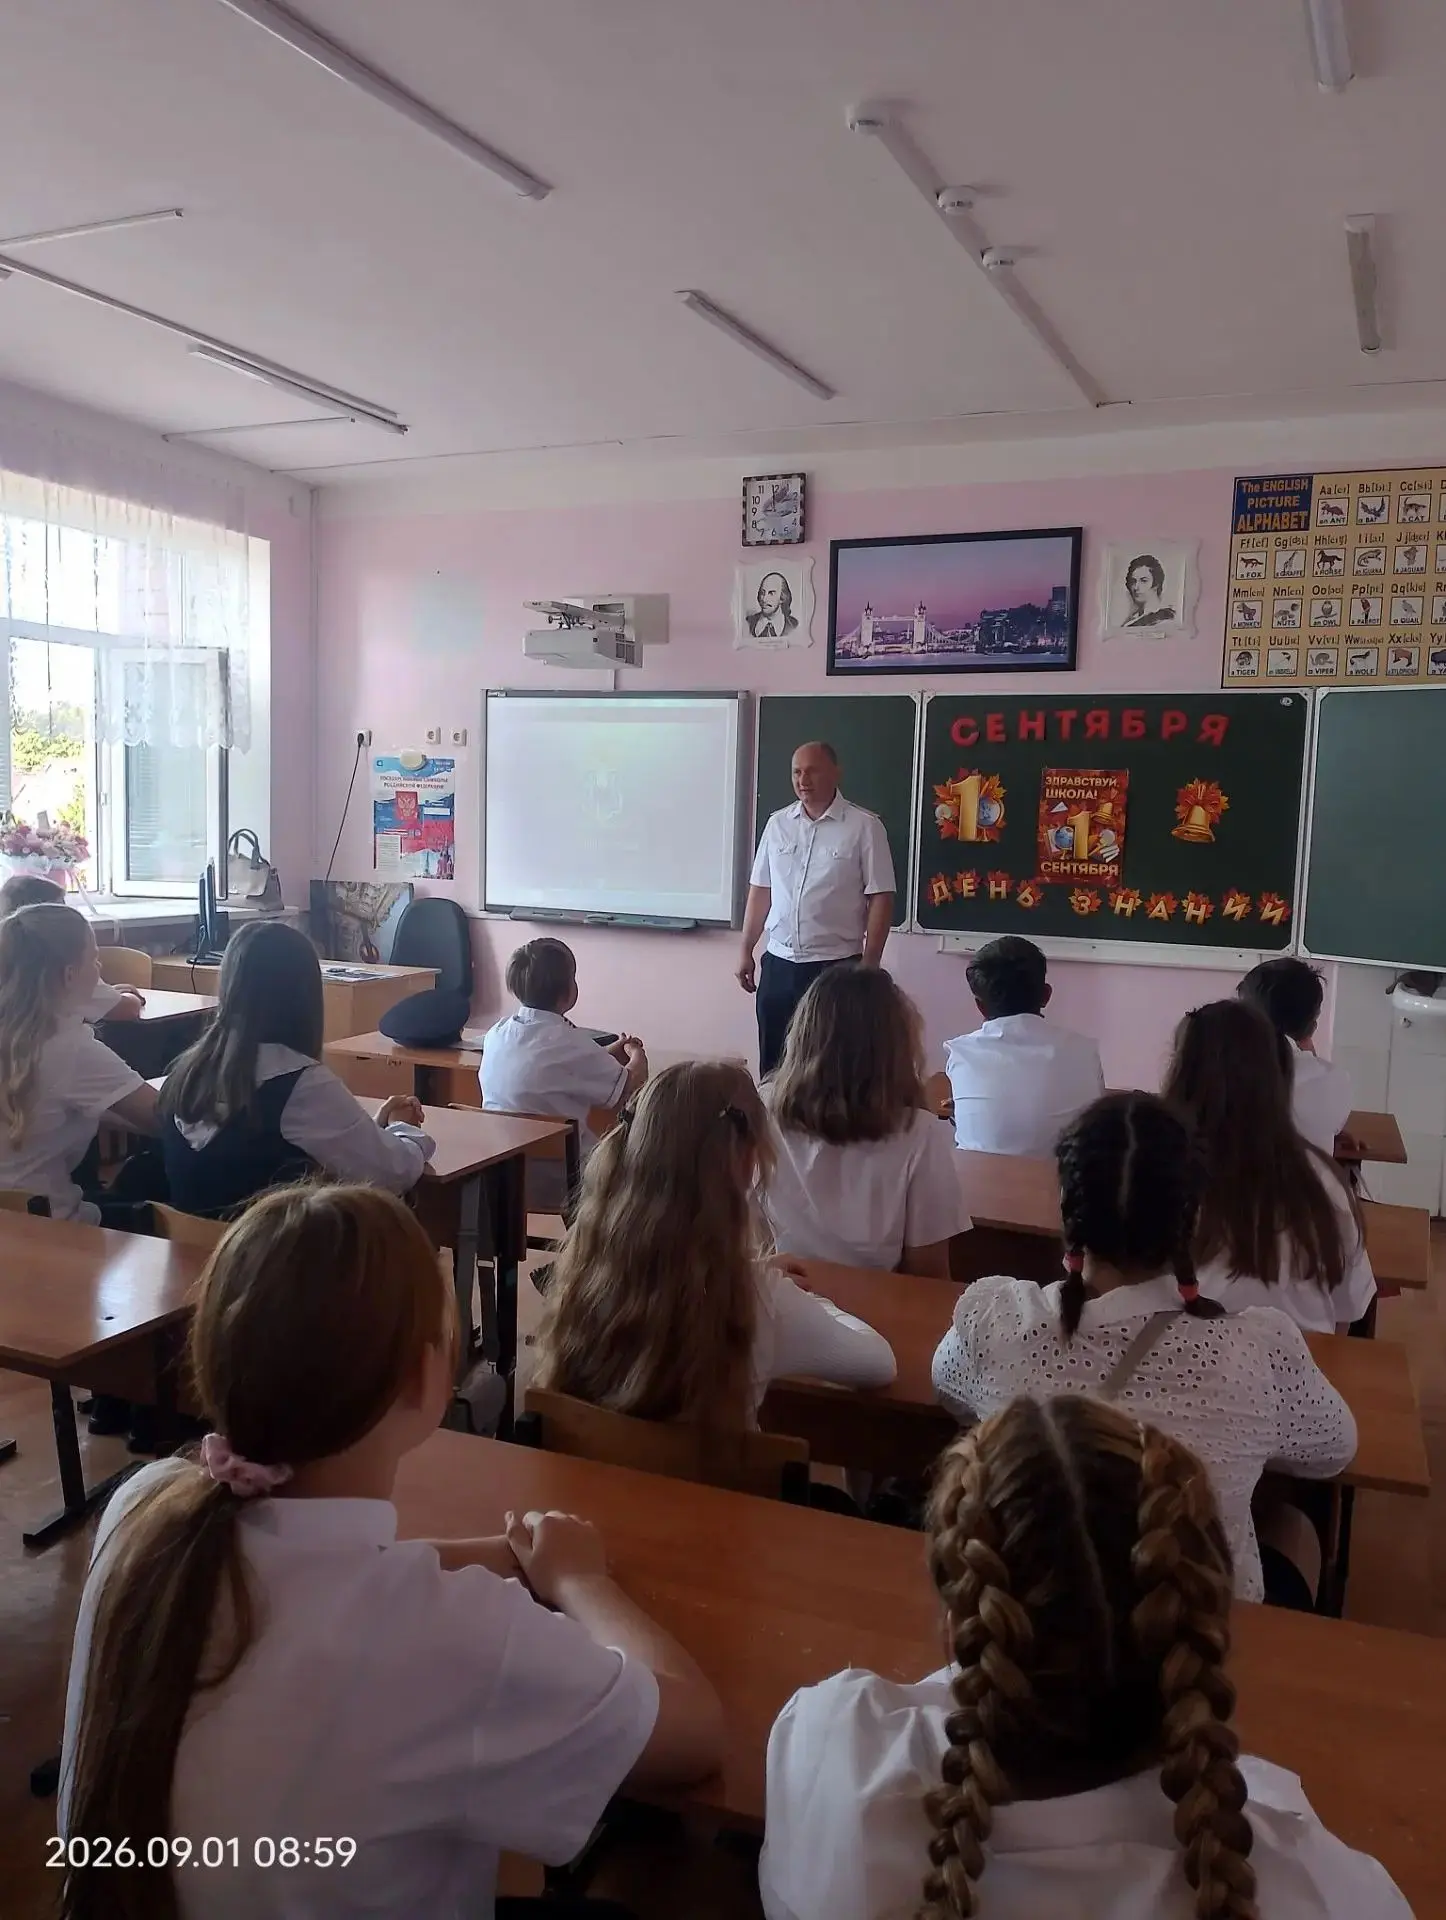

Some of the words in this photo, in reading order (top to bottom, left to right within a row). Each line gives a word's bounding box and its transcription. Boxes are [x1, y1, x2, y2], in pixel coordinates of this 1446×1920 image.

[1242, 481, 1260, 493] The
[1263, 479, 1309, 492] ENGLISH
[1248, 495, 1300, 508] PICTURE
[1237, 511, 1308, 532] ALPHABET
[950, 709, 1229, 747] СЕНТЯБРЯ
[1045, 788, 1098, 799] ШКОЛА!
[951, 775, 981, 841] 1
[1040, 861, 1119, 876] СЕНТЯБРЯ
[932, 878, 1035, 908] ДЕНЬ
[1072, 894, 1285, 926] ЗНАНИЙ
